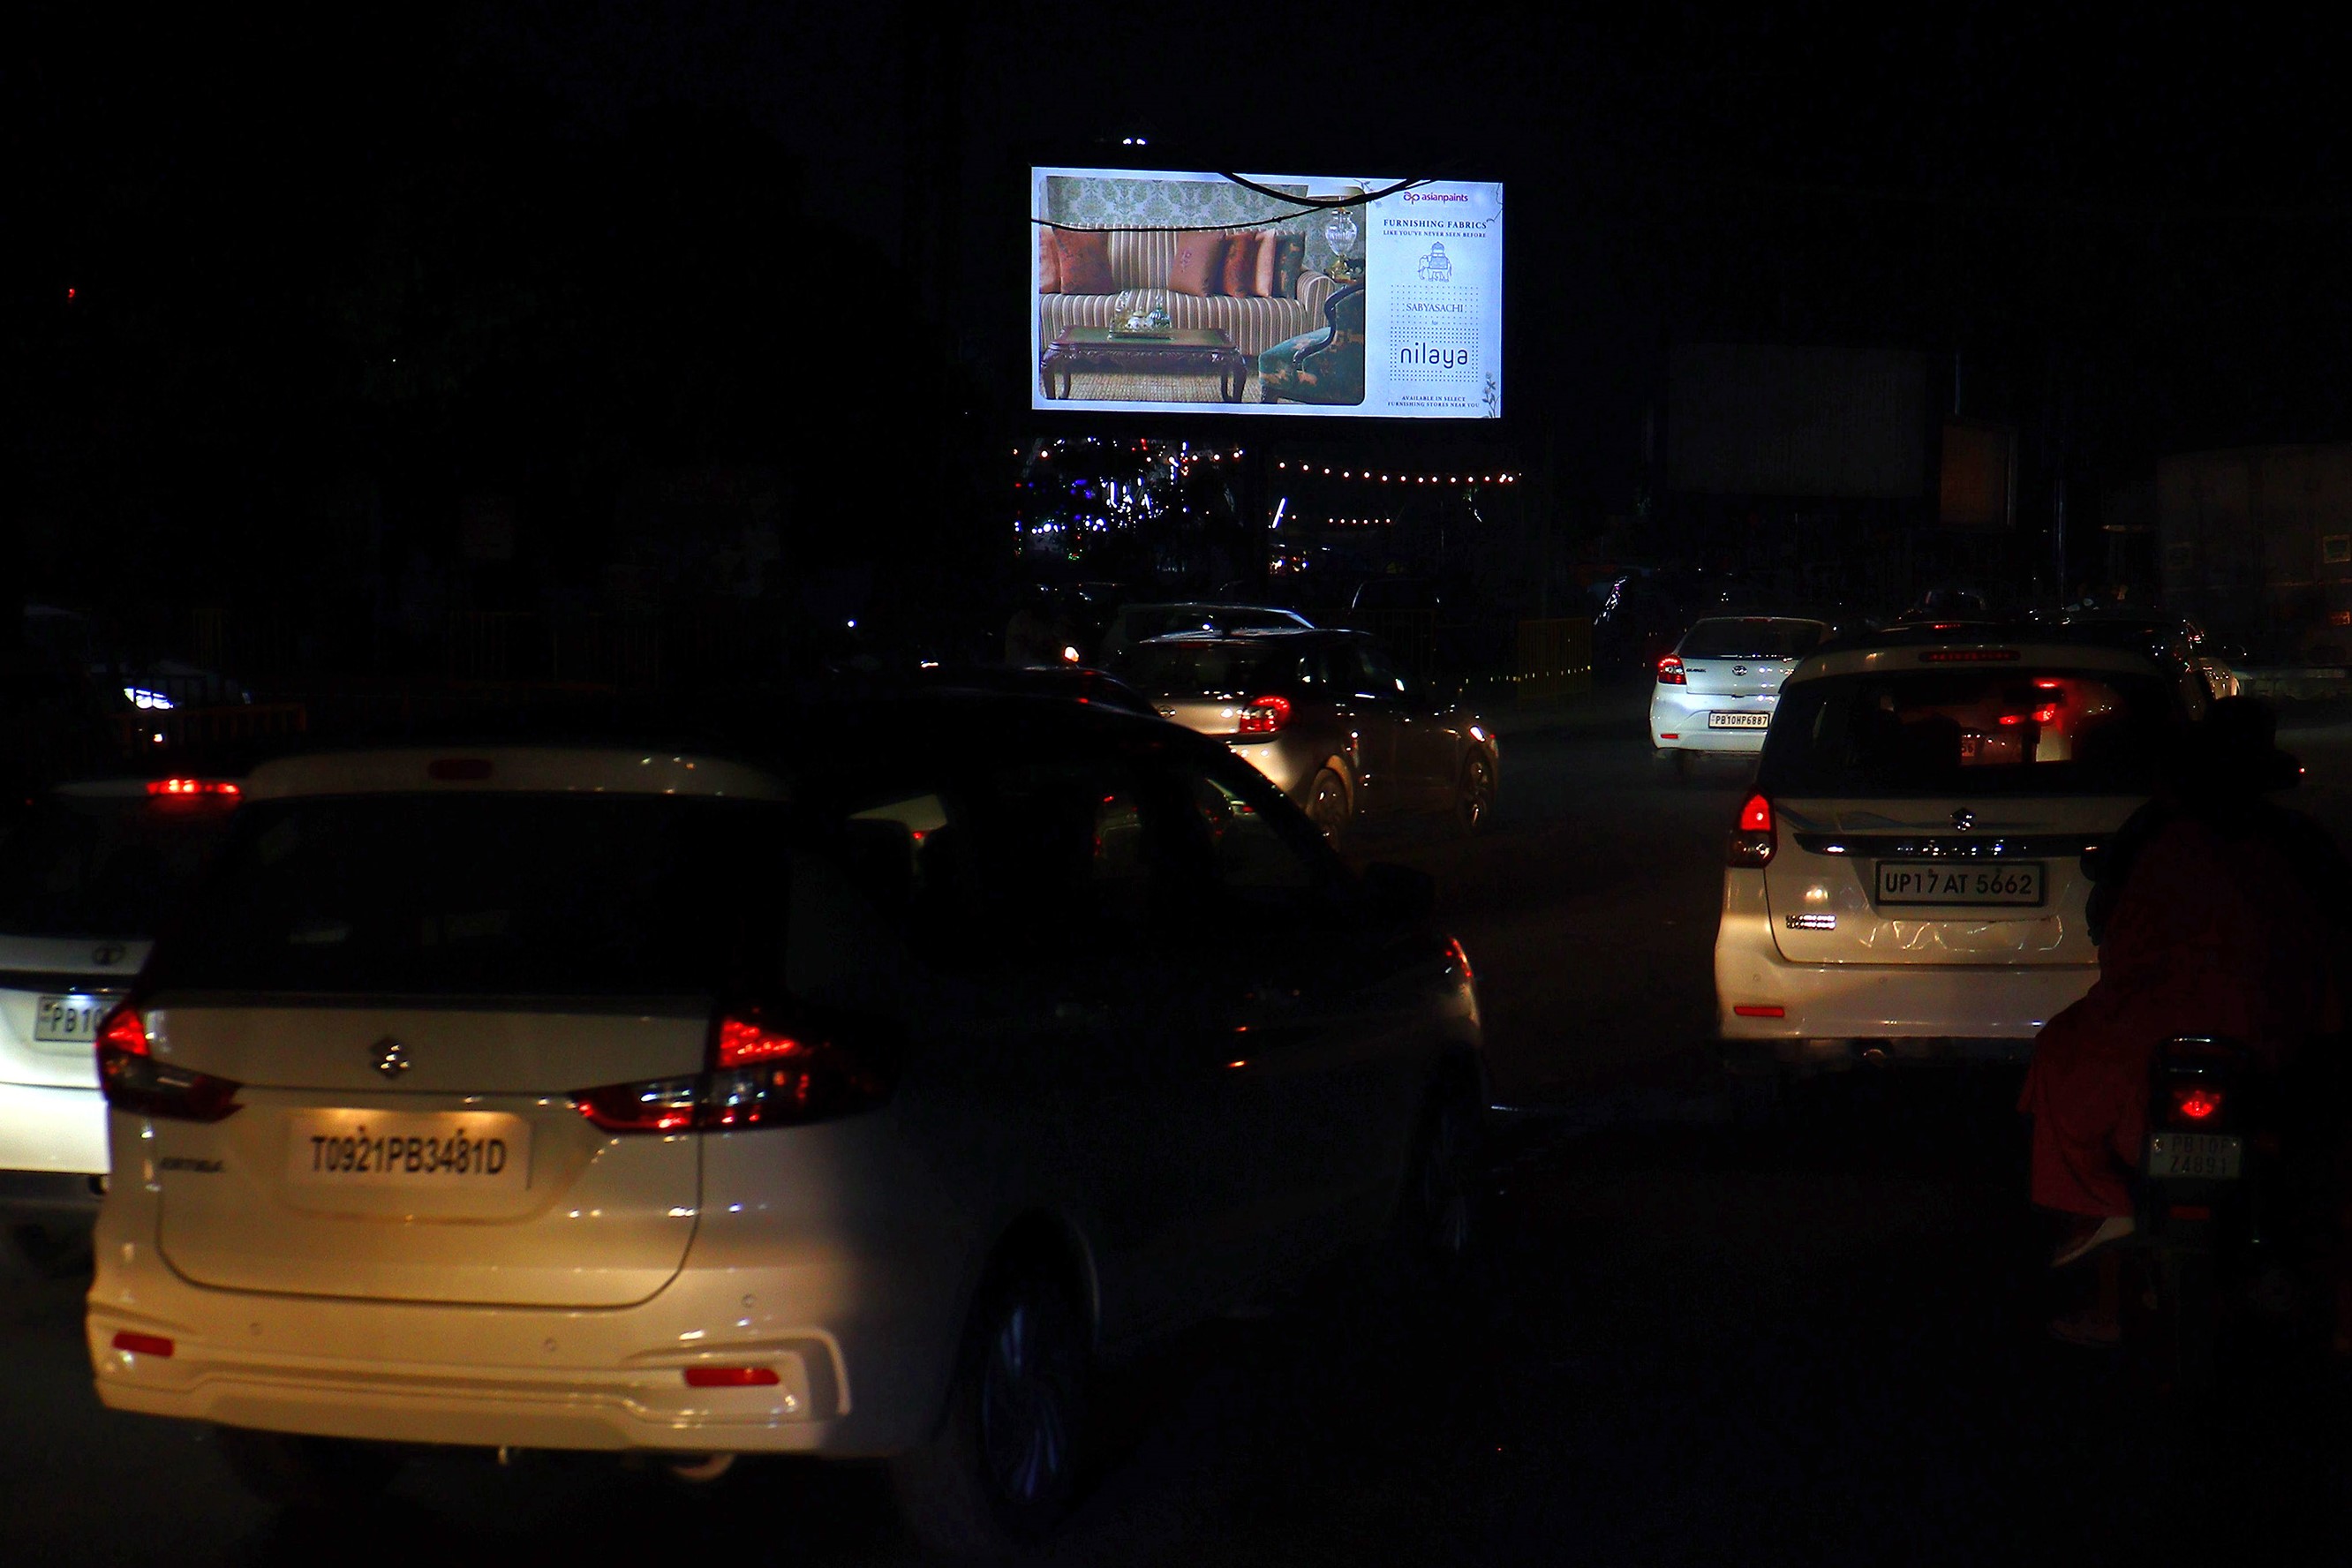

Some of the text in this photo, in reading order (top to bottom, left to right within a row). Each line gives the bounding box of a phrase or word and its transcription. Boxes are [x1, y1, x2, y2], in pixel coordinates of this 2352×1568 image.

[1421, 192, 1468, 204] asianpaints
[1383, 219, 1444, 228] FURNISHING
[1406, 303, 1464, 313] SABYASACHI
[1400, 342, 1468, 369] nilaya
[1715, 715, 1767, 725] PB10HP6887
[1885, 872, 2032, 894] UP17 AT 5662
[311, 1135, 507, 1175] T0921PB3481D
